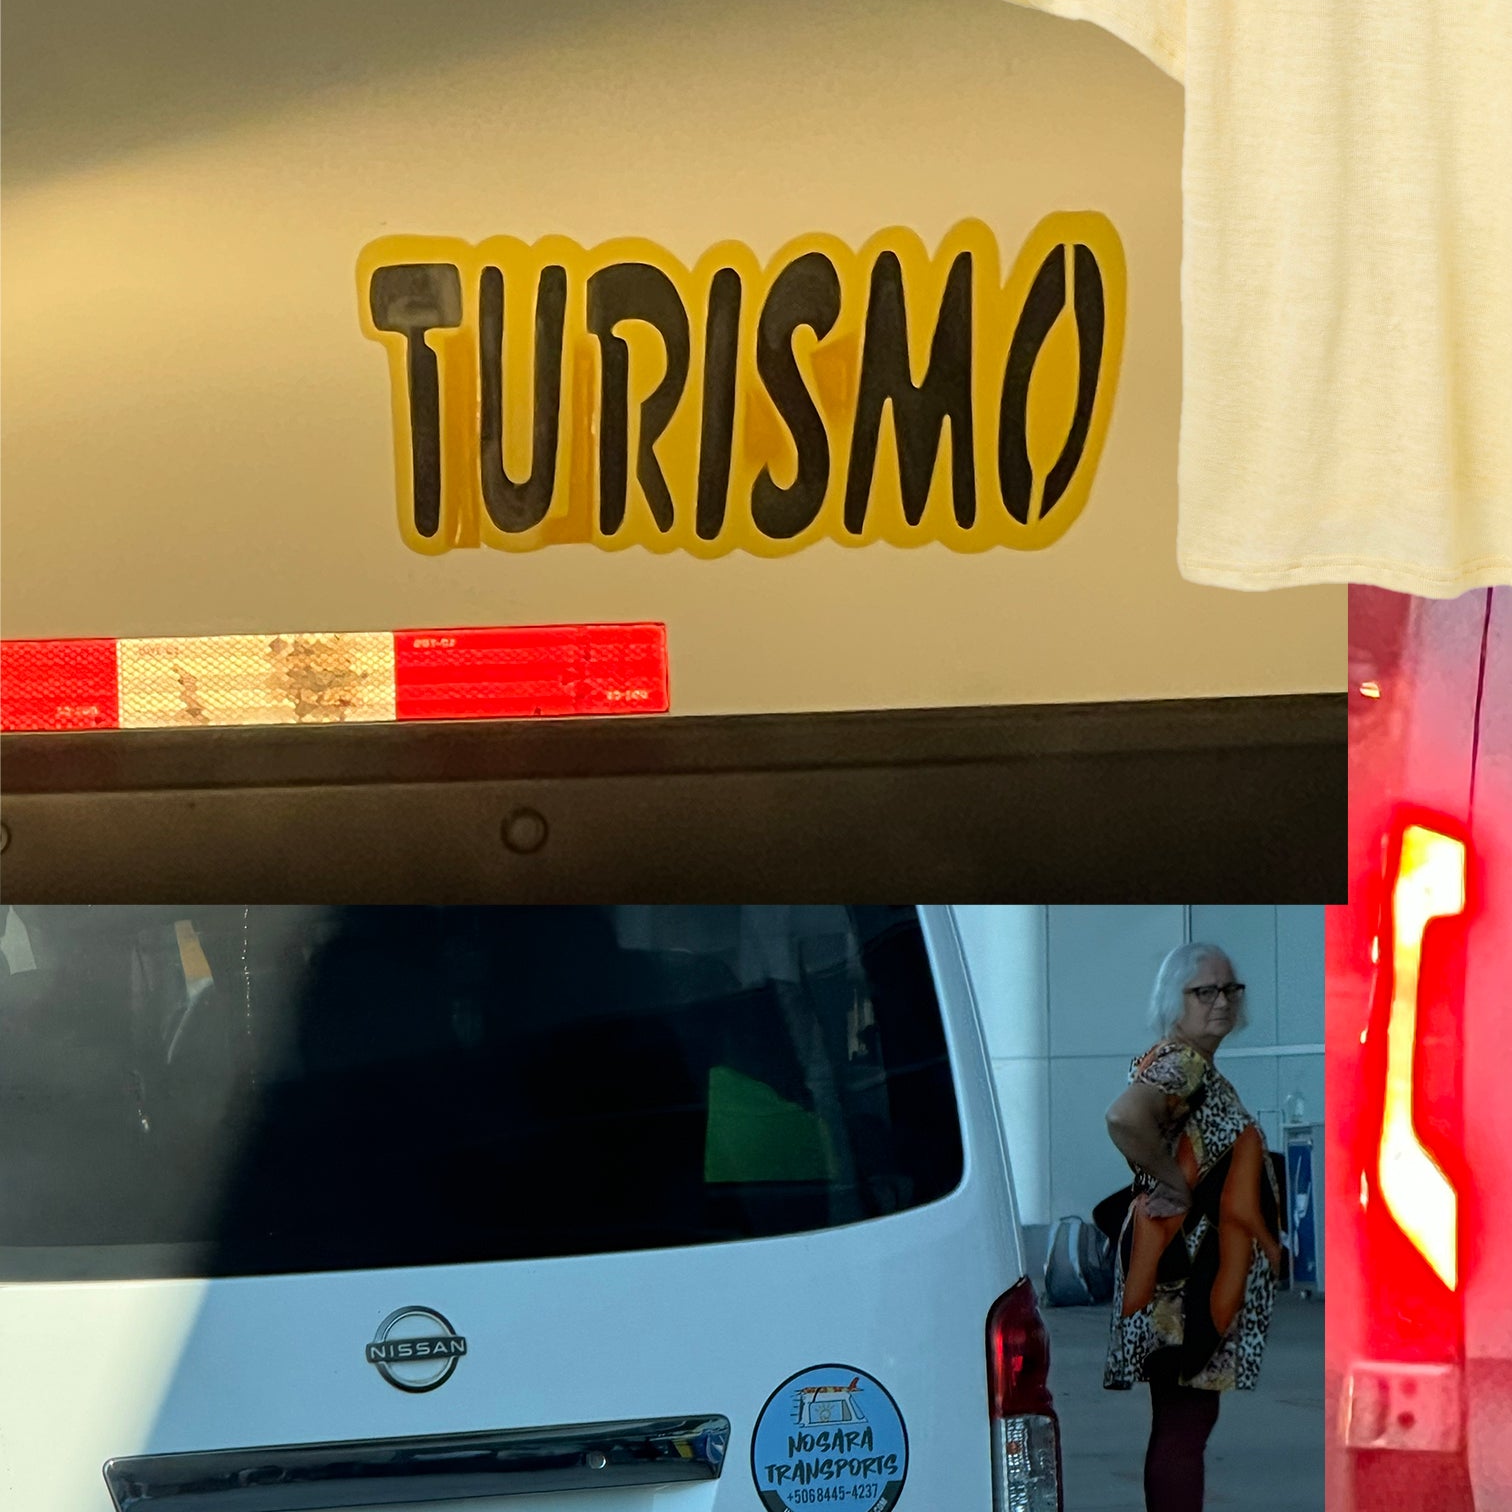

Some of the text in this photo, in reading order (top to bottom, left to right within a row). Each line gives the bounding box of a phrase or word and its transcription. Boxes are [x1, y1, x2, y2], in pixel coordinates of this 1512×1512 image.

[369, 243, 1105, 540] TURISMO
[370, 1340, 465, 1359] NISSAN
[788, 1426, 873, 1458] NOSARA
[765, 1454, 899, 1486] TRANSPORTS
